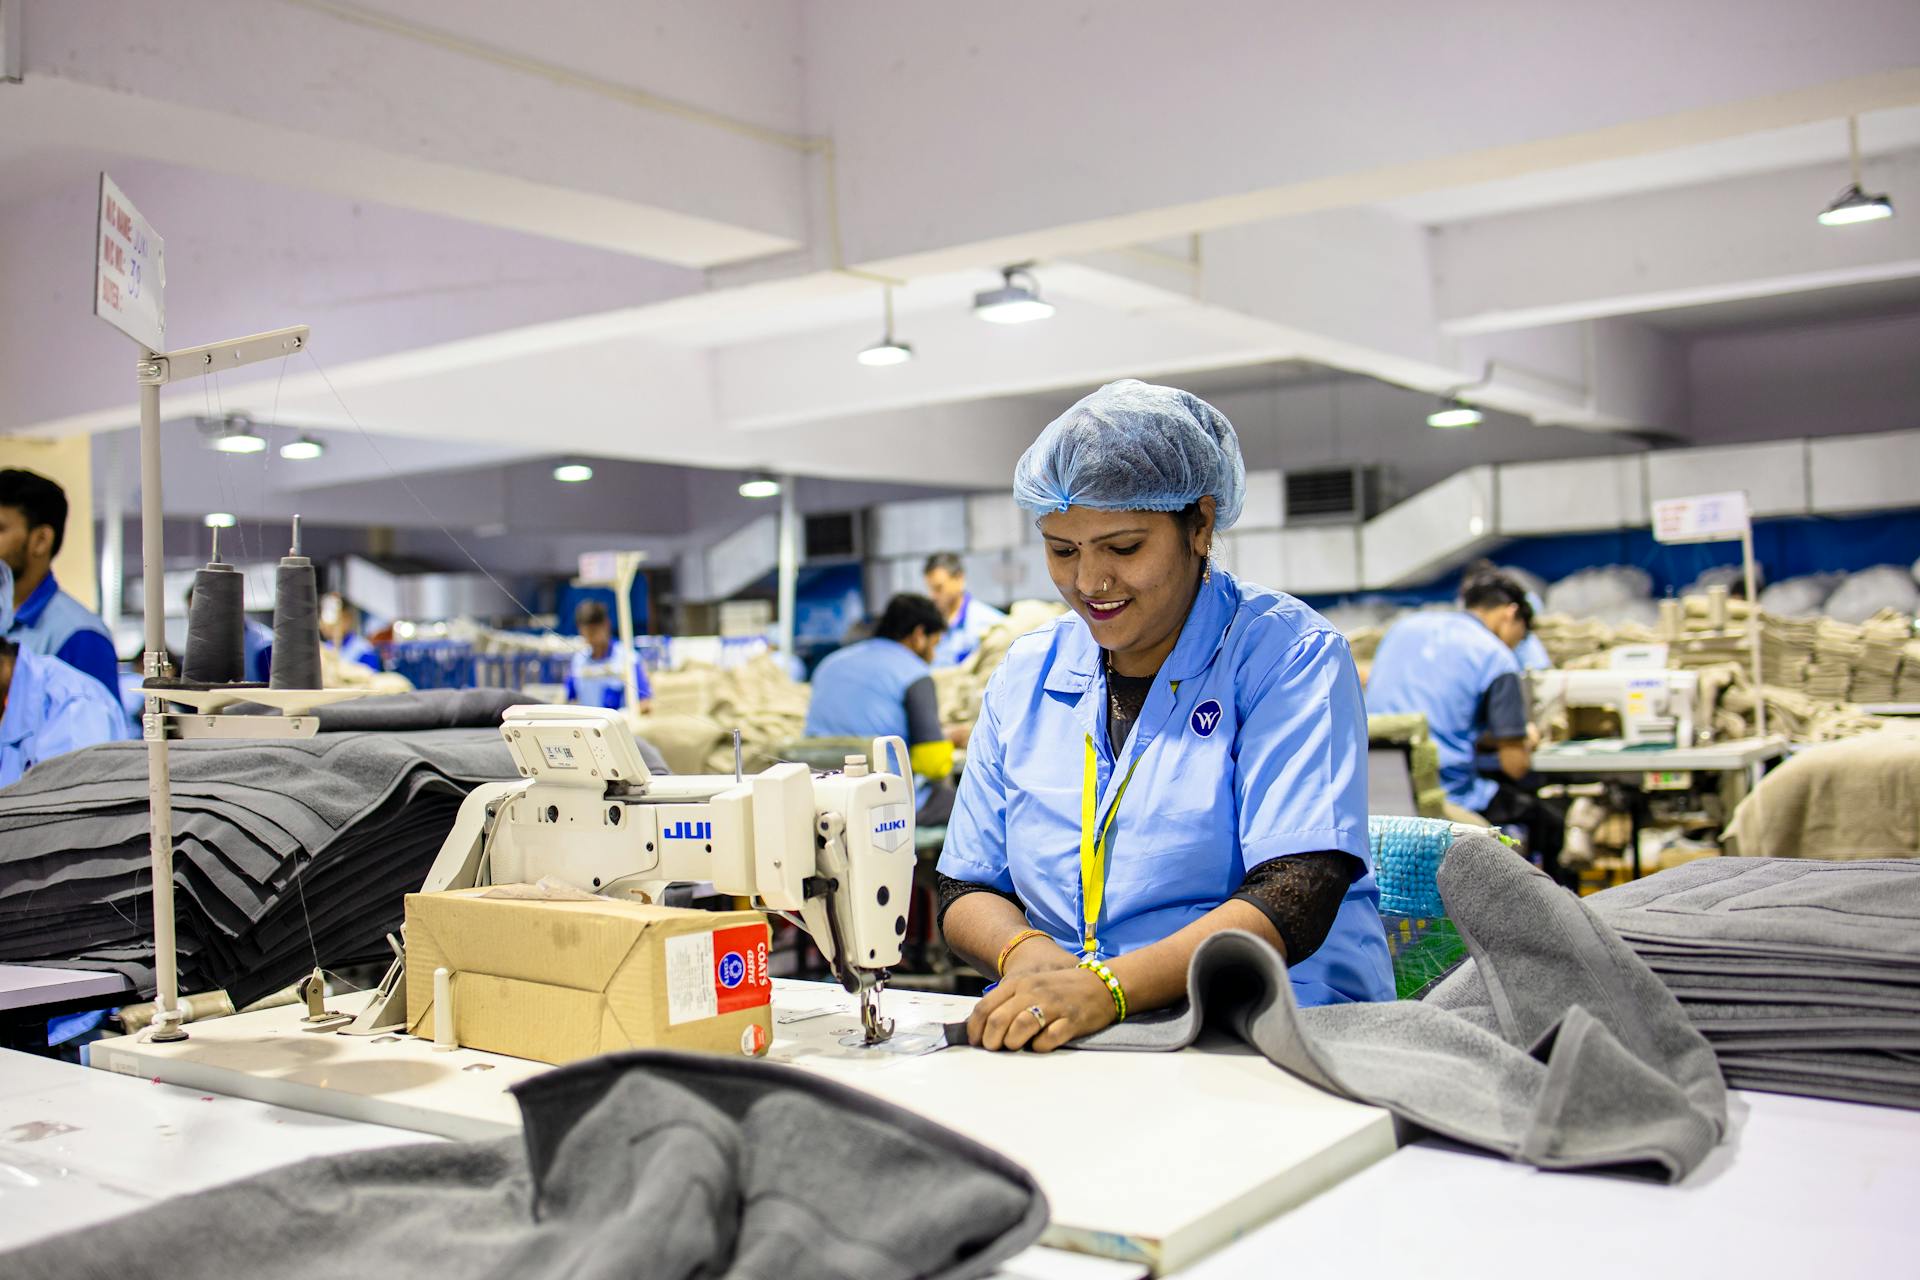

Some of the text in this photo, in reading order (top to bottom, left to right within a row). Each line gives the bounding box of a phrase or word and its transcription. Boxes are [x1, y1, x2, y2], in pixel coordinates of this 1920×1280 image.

[1195, 711, 1220, 730] W
[875, 819, 905, 833] JUKI
[747, 949, 757, 985] astra
[757, 942, 768, 986] COATS
